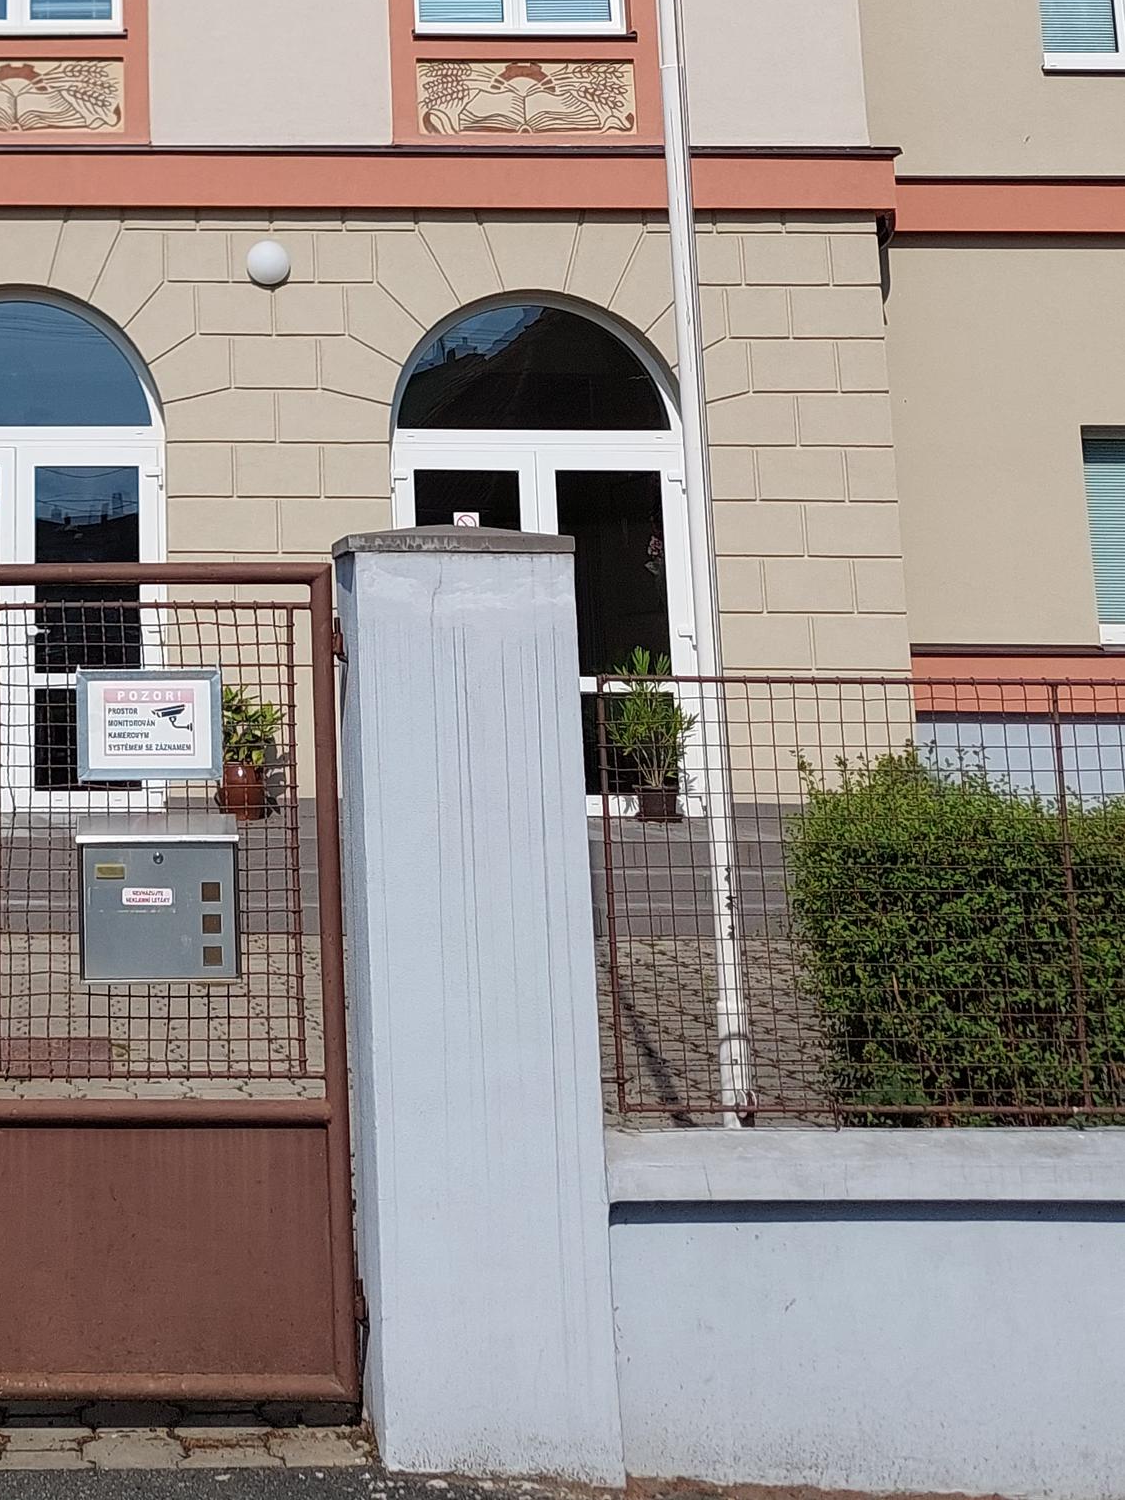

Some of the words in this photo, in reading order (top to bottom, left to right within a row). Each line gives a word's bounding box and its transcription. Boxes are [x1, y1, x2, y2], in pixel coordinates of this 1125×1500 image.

[117, 690, 182, 701] POZOR!
[107, 707, 138, 715] PROSTOR
[107, 718, 156, 727] MONITOROVÁN
[107, 730, 150, 739] KAMEROVÝM
[107, 743, 144, 751] SYSTÉMEM
[155, 743, 192, 751] ZÁZNAMEM
